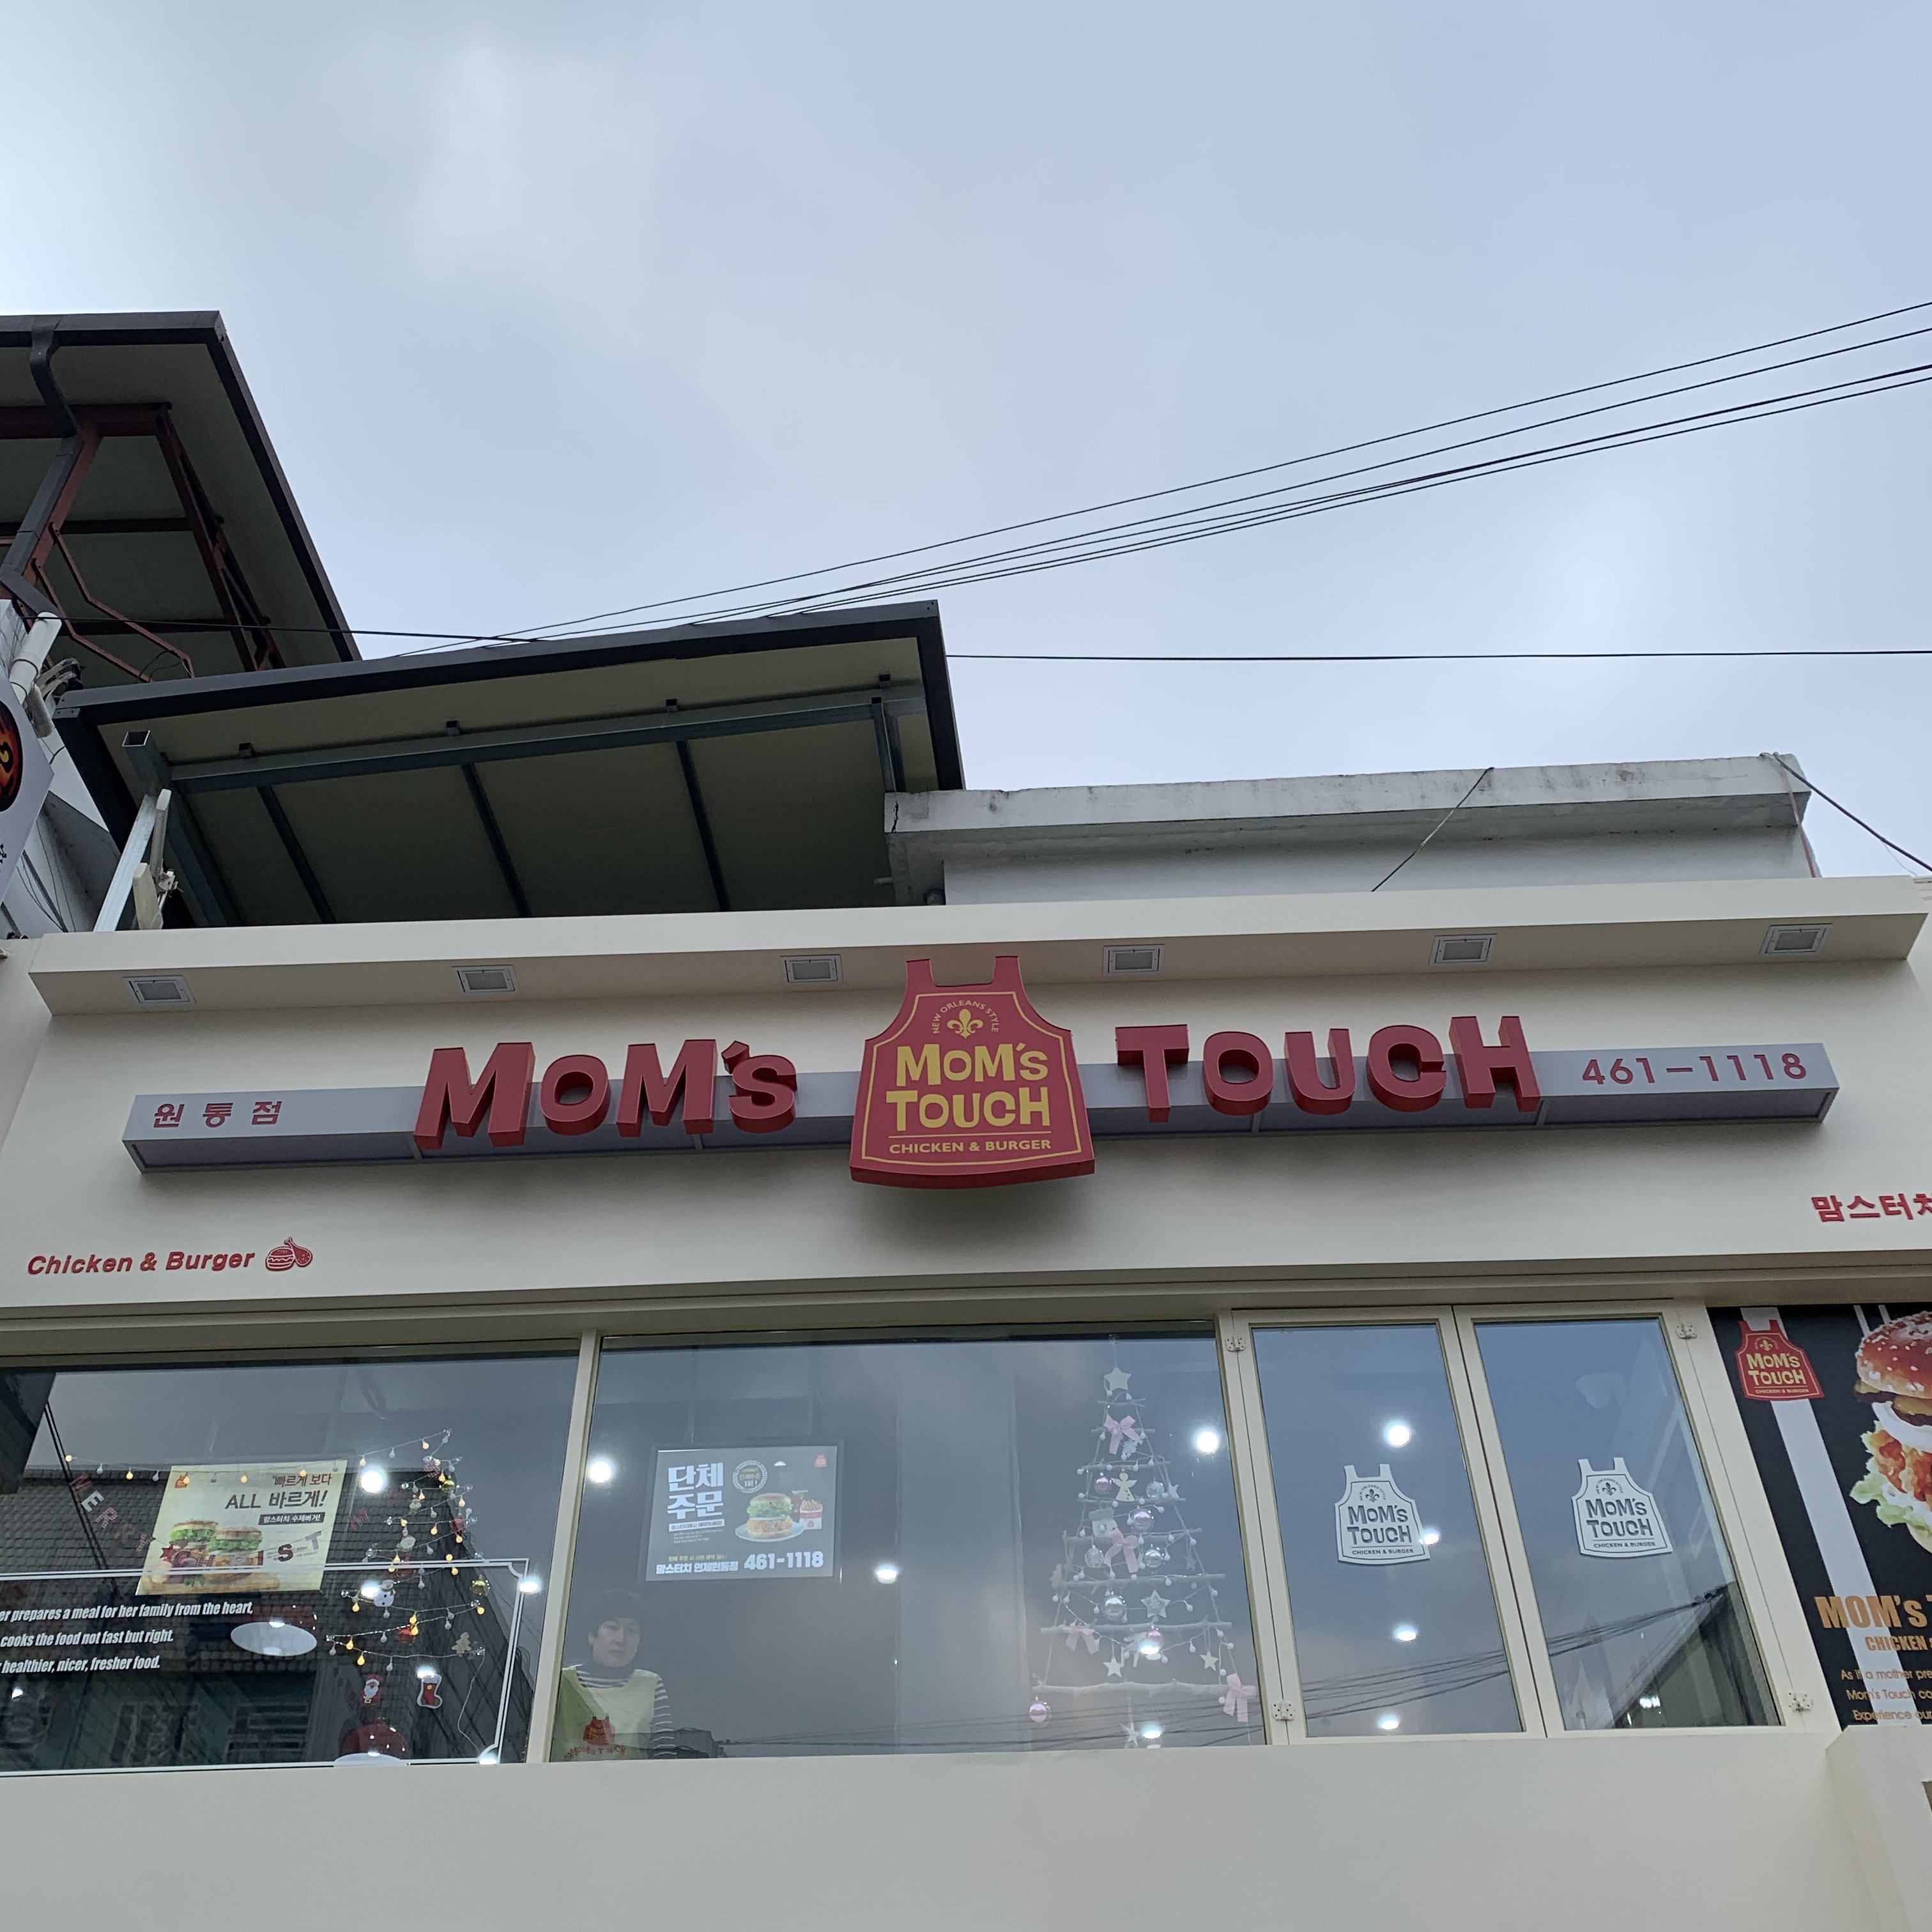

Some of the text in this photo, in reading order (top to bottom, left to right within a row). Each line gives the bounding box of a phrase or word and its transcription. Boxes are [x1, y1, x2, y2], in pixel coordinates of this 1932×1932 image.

[932, 1000, 999, 1034] NEW ORLEANS STYLE
[1116, 1016, 1541, 1123] TOUCH
[1582, 1053, 1807, 1085] 461-1118
[886, 1087, 1050, 1131] TOUCH
[889, 1139, 1052, 1154] CHICKEN & BURGER
[27, 1250, 256, 1275] Chicken & Burger
[1747, 1369, 1807, 1386] TOUCH
[274, 1473, 332, 1487] 빠르게 보다
[668, 1462, 724, 1492] 단체
[225, 1490, 328, 1509] ALL 바르게!
[667, 1491, 724, 1519] 주문
[263, 1514, 289, 1523] 맘스터치
[1586, 1518, 1653, 1538] TOUCH
[1347, 1525, 1412, 1545] TOUCH
[744, 1551, 824, 1571] 461-1118
[10, 1608, 62, 1623] prepares
[63, 1608, 70, 1620] a
[71, 1606, 101, 1620] meal
[100, 1605, 119, 1618] for
[118, 1605, 139, 1618] her
[139, 1604, 174, 1617] family
[174, 1603, 201, 1616] from
[202, 1602, 220, 1615] the
[222, 1602, 253, 1614] heart,
[0, 1629, 173, 1648] cooks the food not fast but right.
[1864, 1636, 1928, 1651] CHICKEN
[1, 1659, 55, 1674] healthier,
[56, 1658, 88, 1673] nicer,
[89, 1657, 134, 1671] fresher
[132, 1655, 160, 1669] food.
[1841, 1669, 1854, 1680] As
[1855, 1669, 1862, 1680] if
[1865, 1671, 1874, 1679] a
[1876, 1668, 1913, 1680] mother
[1845, 1689, 1881, 1700] Mom's
[1882, 1689, 1916, 1699] Touch
[1853, 1710, 1912, 1721] Experience
